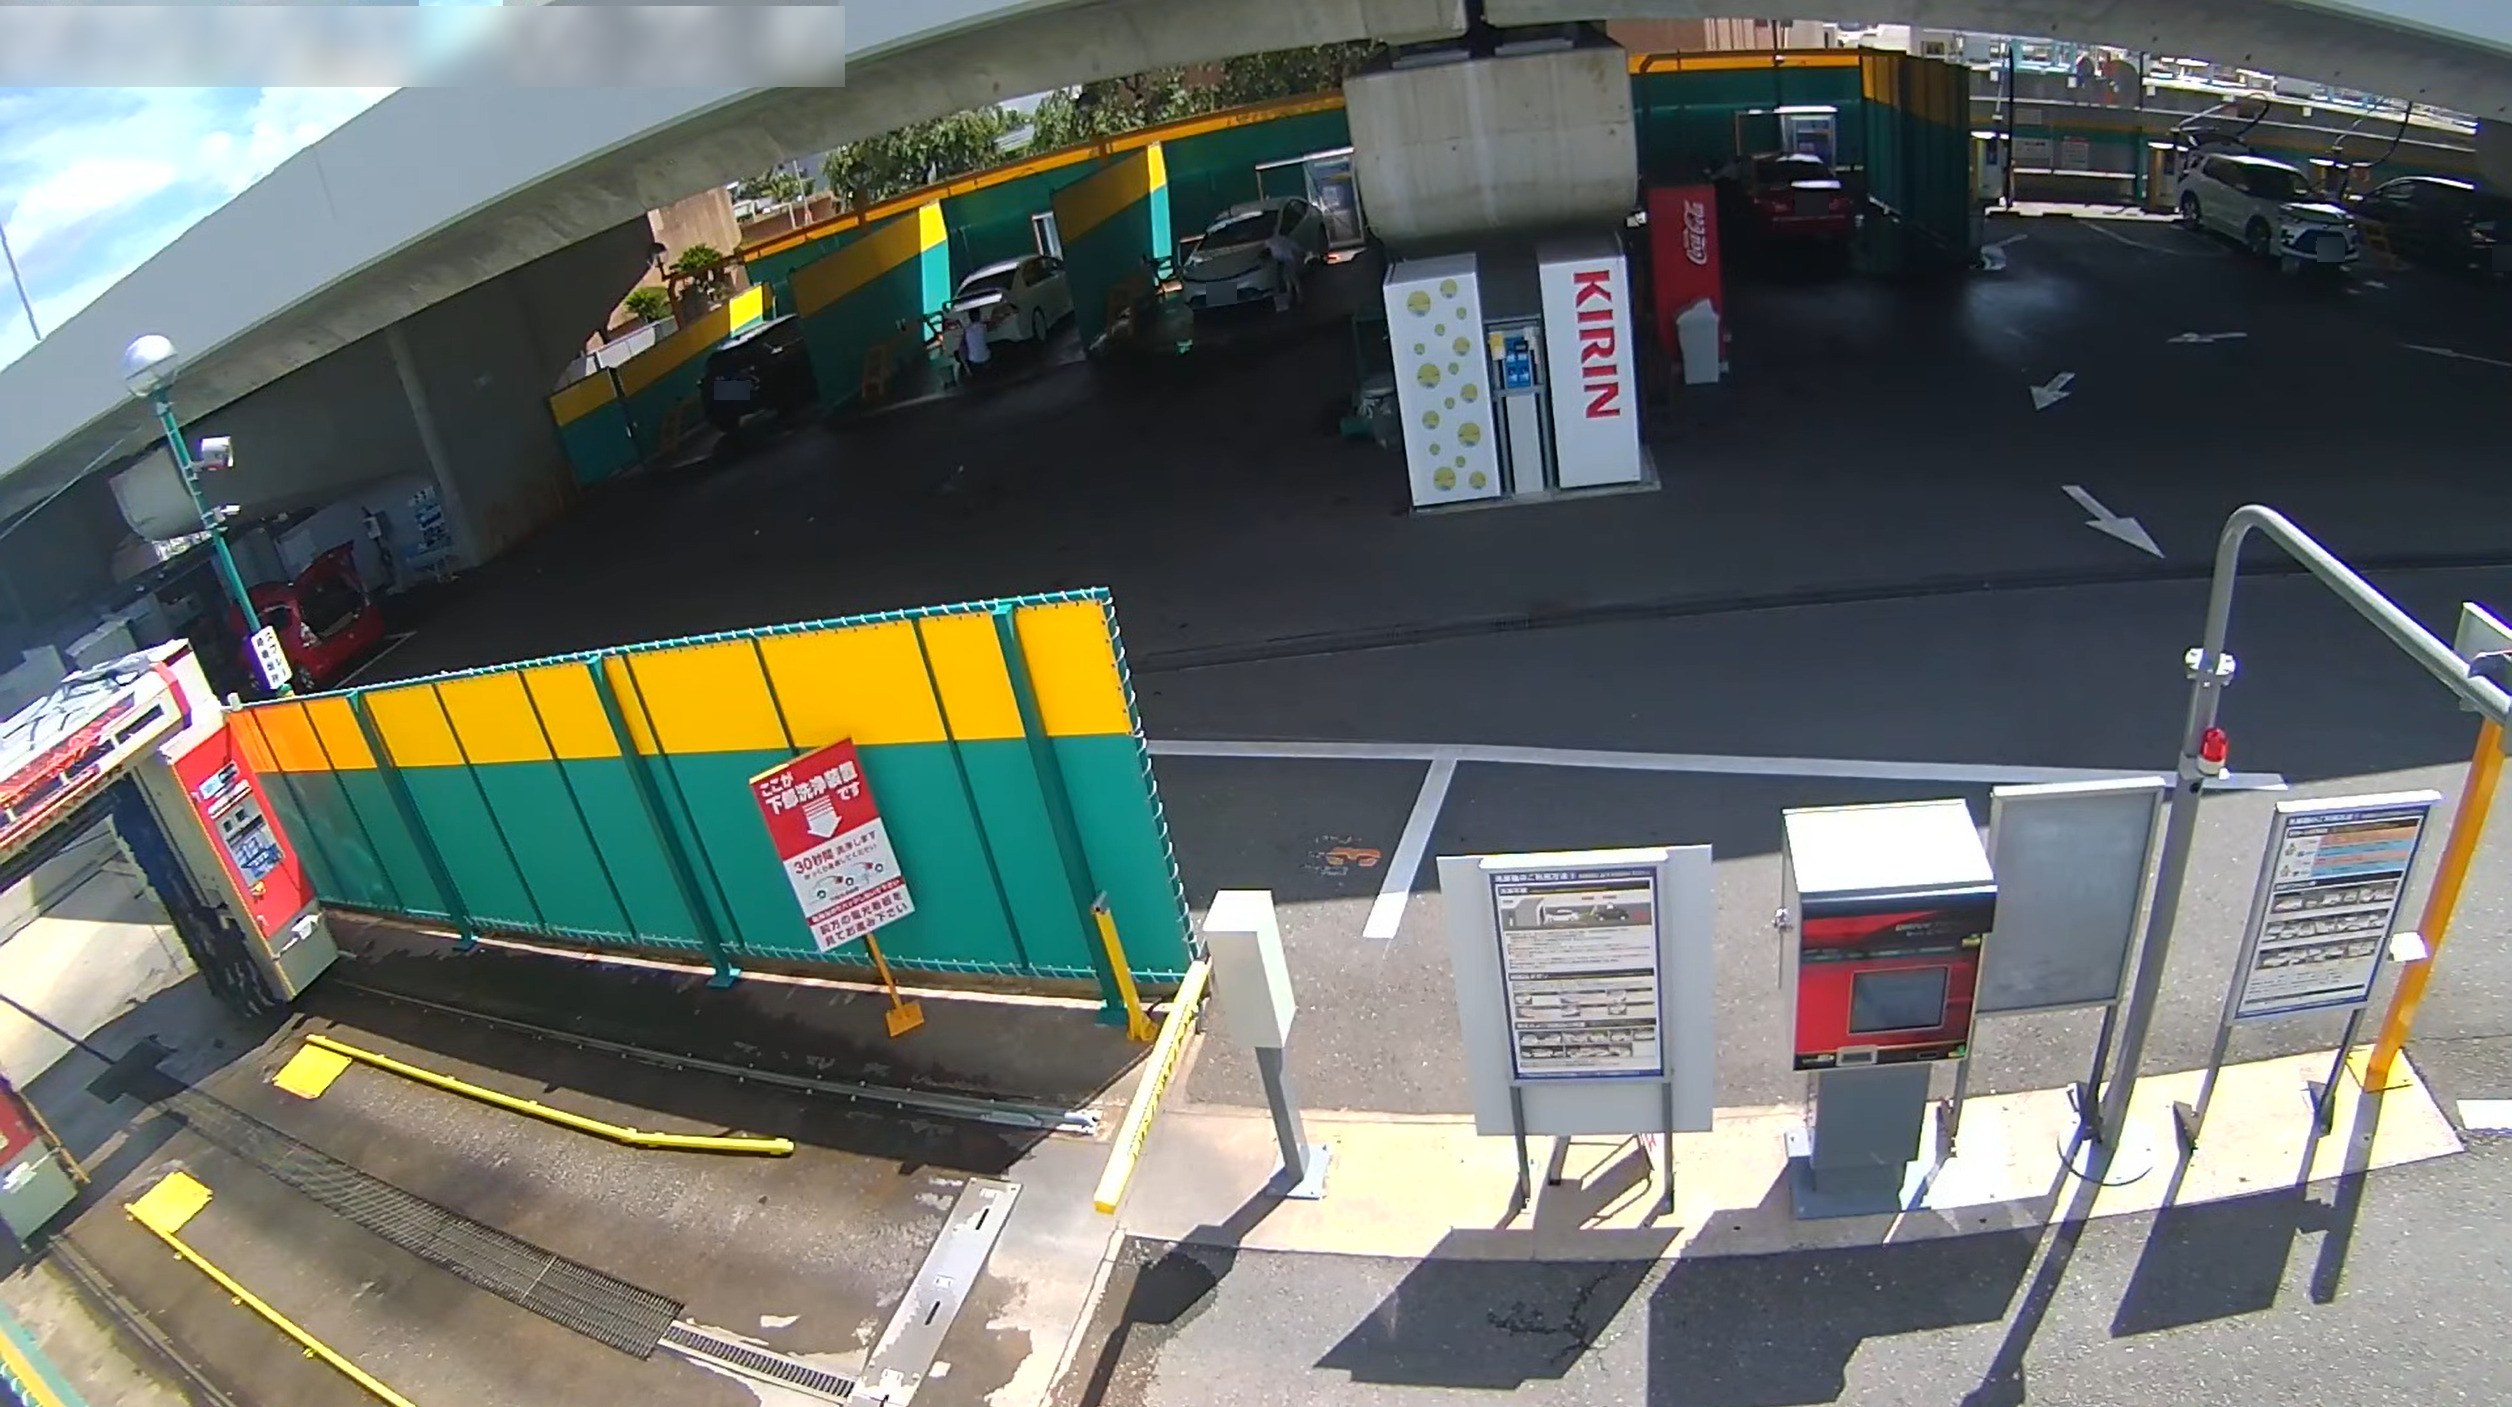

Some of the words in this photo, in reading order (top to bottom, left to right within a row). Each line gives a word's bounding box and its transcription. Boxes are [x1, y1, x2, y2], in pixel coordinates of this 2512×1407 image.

[1573, 270, 1620, 418] KIRIN
[760, 771, 793, 797] ここが
[765, 760, 858, 815] 下部洗浄装置
[836, 781, 860, 800] です
[794, 848, 834, 874] 30秒間
